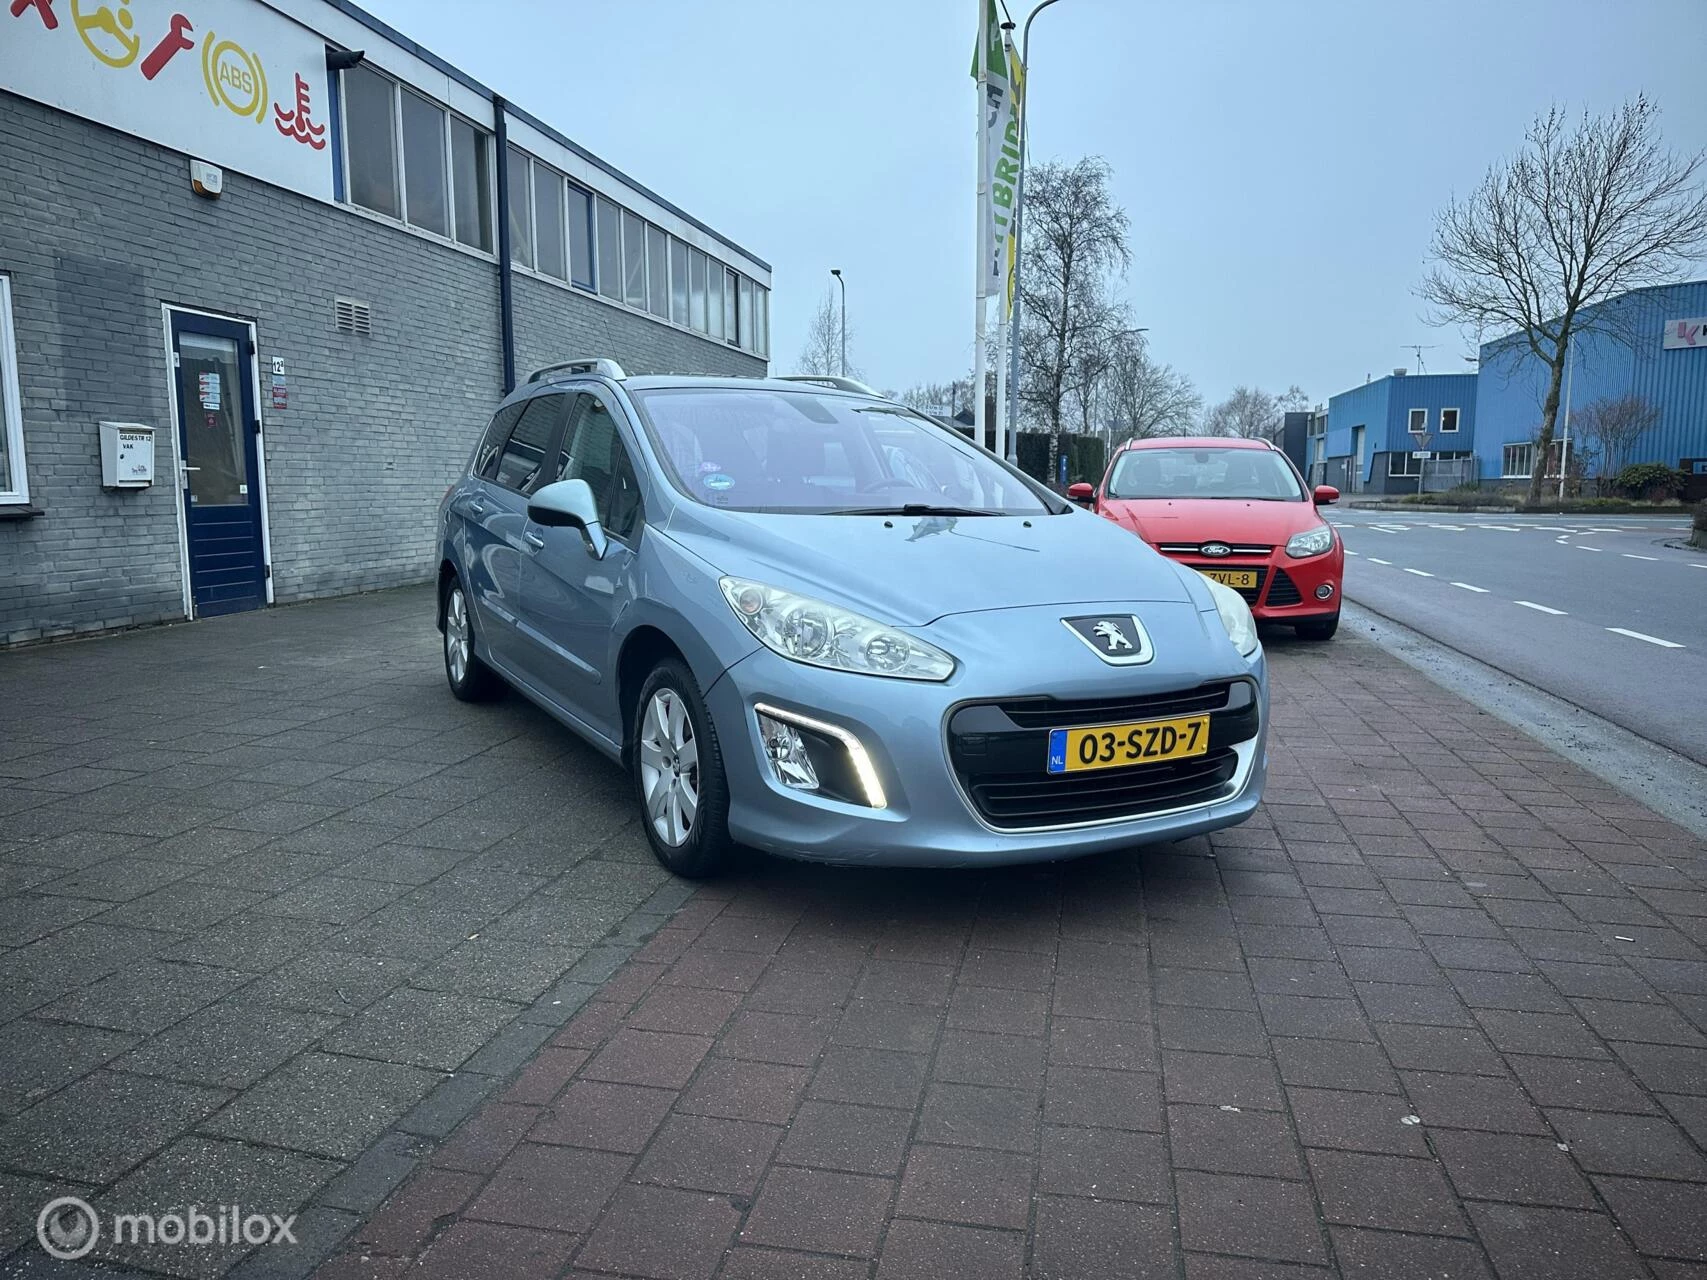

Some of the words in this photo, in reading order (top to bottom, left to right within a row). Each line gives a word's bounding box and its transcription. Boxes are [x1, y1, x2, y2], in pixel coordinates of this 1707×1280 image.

[220, 61, 252, 95] ABS
[1051, 756, 1064, 765] NL
[1079, 722, 1202, 765] 03-SZD-7
